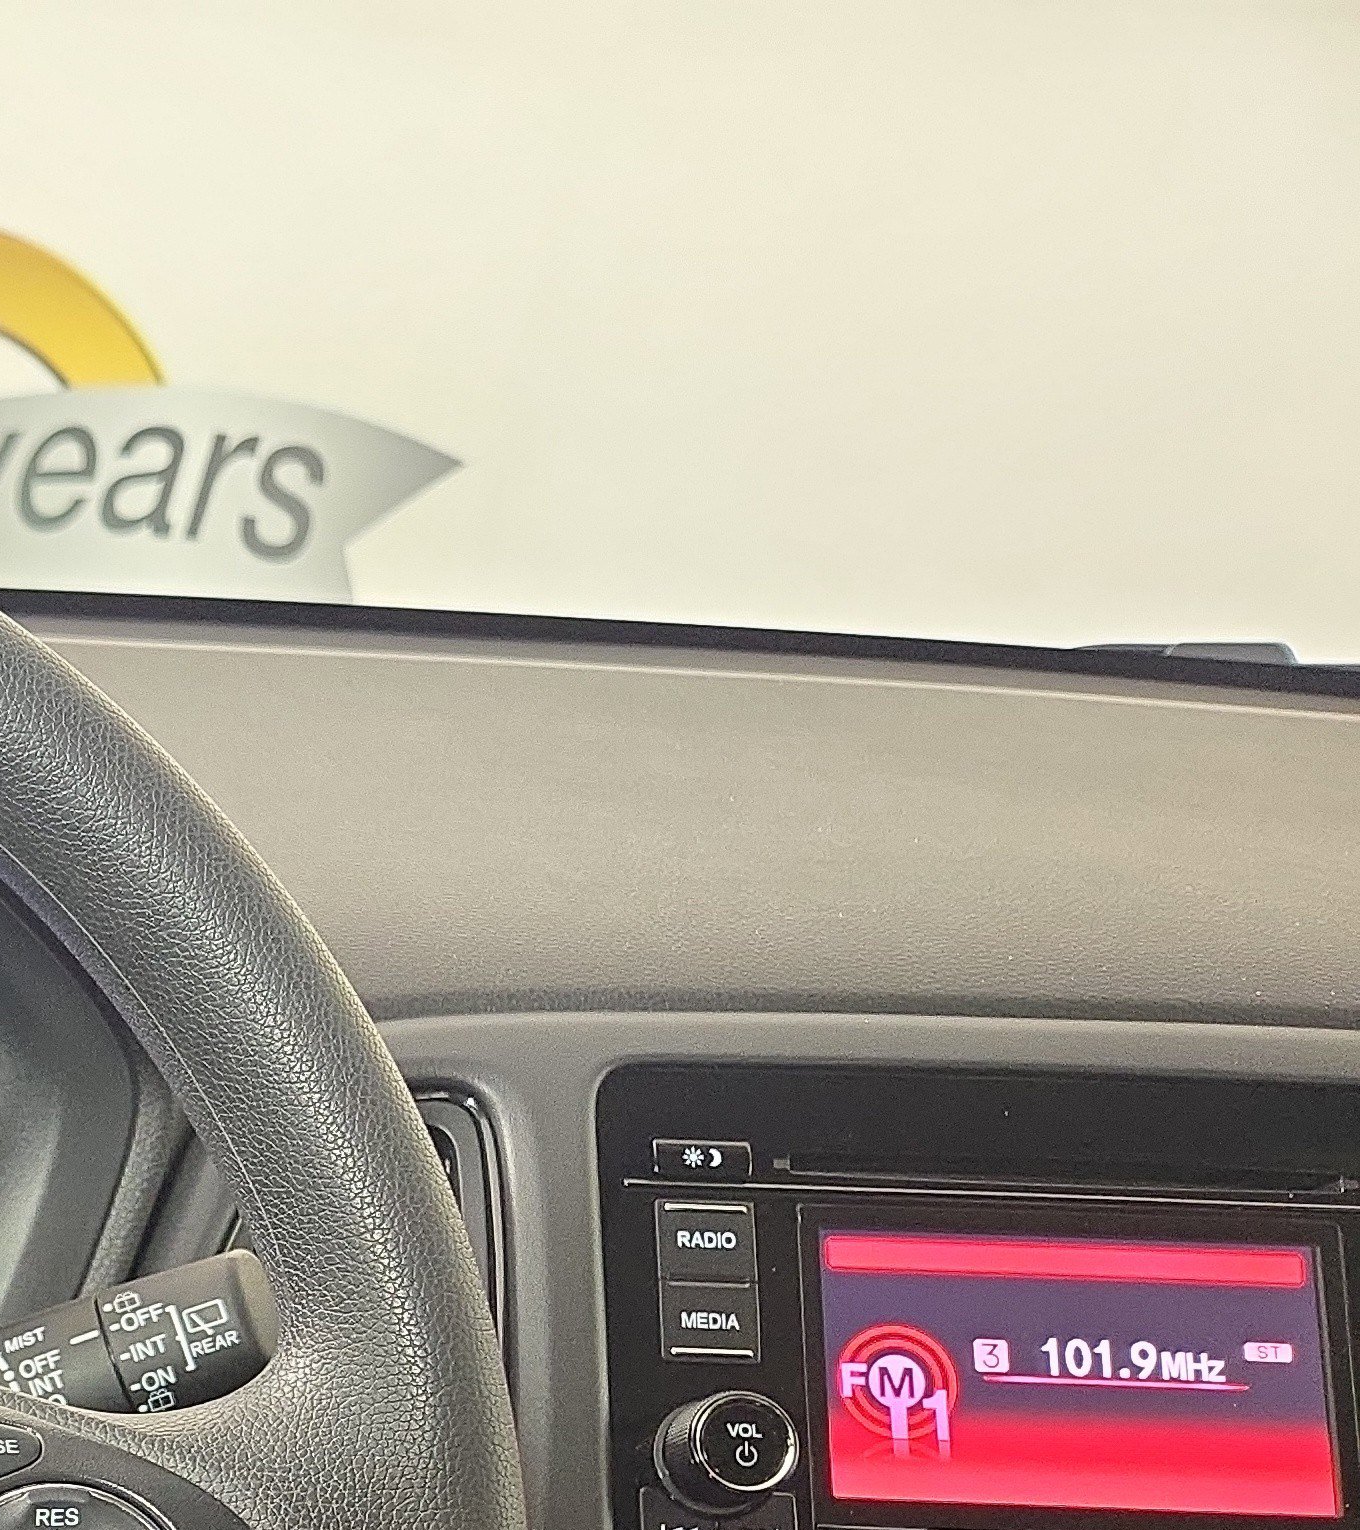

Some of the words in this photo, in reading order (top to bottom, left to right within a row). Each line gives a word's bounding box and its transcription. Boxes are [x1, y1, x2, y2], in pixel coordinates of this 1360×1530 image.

[677, 1231, 737, 1249] RADIO
[120, 1303, 166, 1332] OFF
[681, 1312, 740, 1330] MEDIA
[4, 1326, 45, 1353] MIST
[129, 1334, 166, 1362] INT
[191, 1330, 241, 1358] REAR
[19, 1349, 61, 1378] OFF
[981, 1344, 999, 1368] 3
[1256, 1345, 1280, 1360] ST
[28, 1369, 64, 1397] INT
[141, 1365, 177, 1391] ON
[727, 1422, 763, 1439] VOL
[35, 1508, 79, 1527] RES
